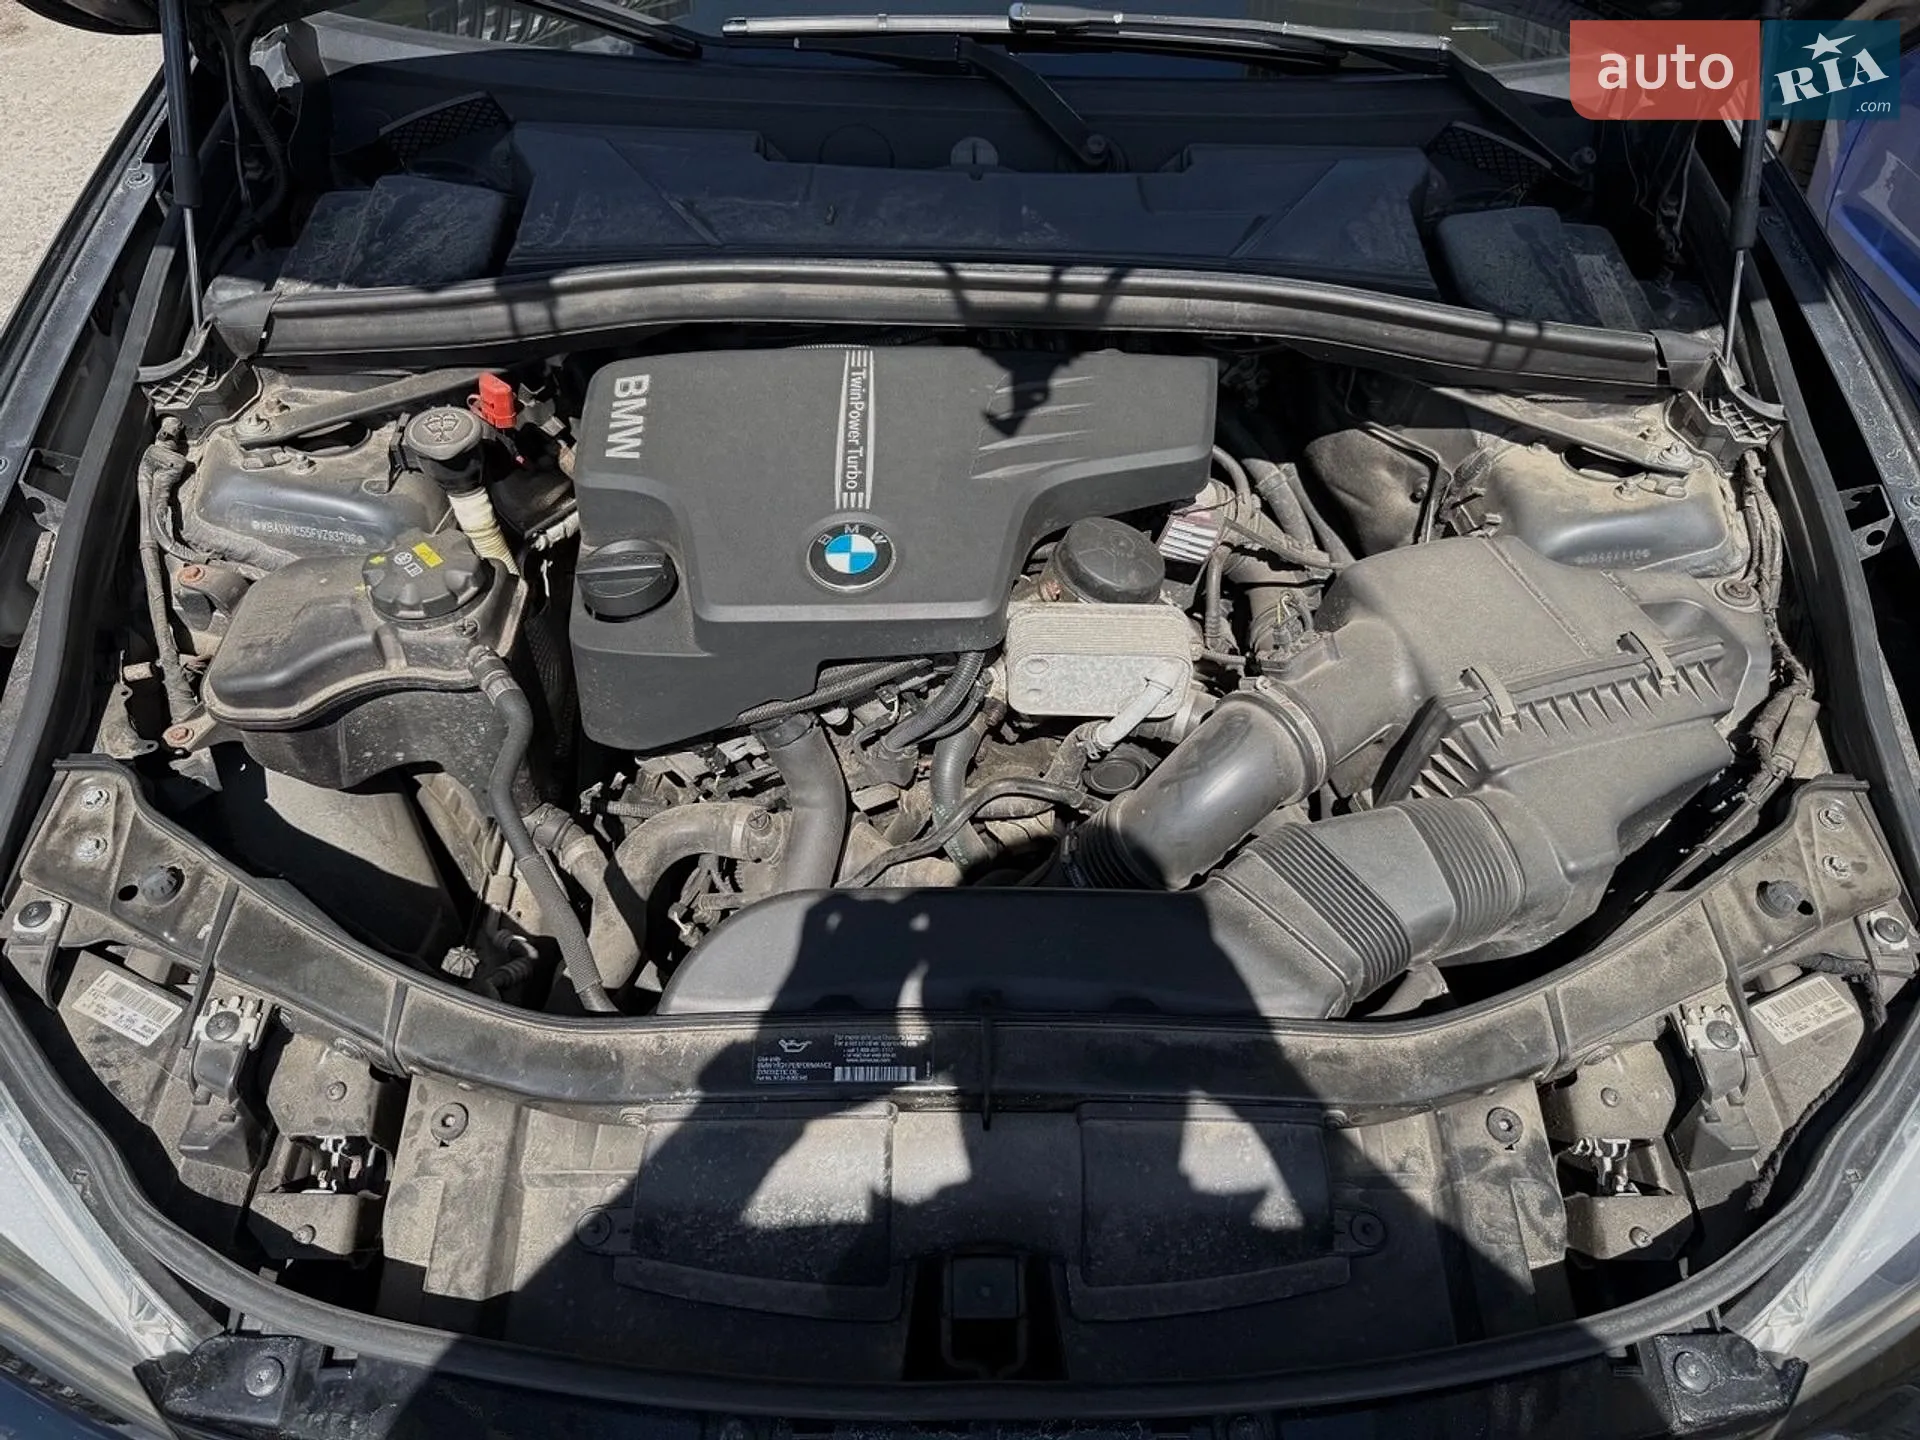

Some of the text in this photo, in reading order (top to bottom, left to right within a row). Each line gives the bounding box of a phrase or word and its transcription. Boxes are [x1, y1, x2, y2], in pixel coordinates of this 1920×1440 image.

[605, 374, 650, 459] BMW
[845, 368, 867, 489] TwinPower Turbo
[817, 523, 888, 546] BMW
